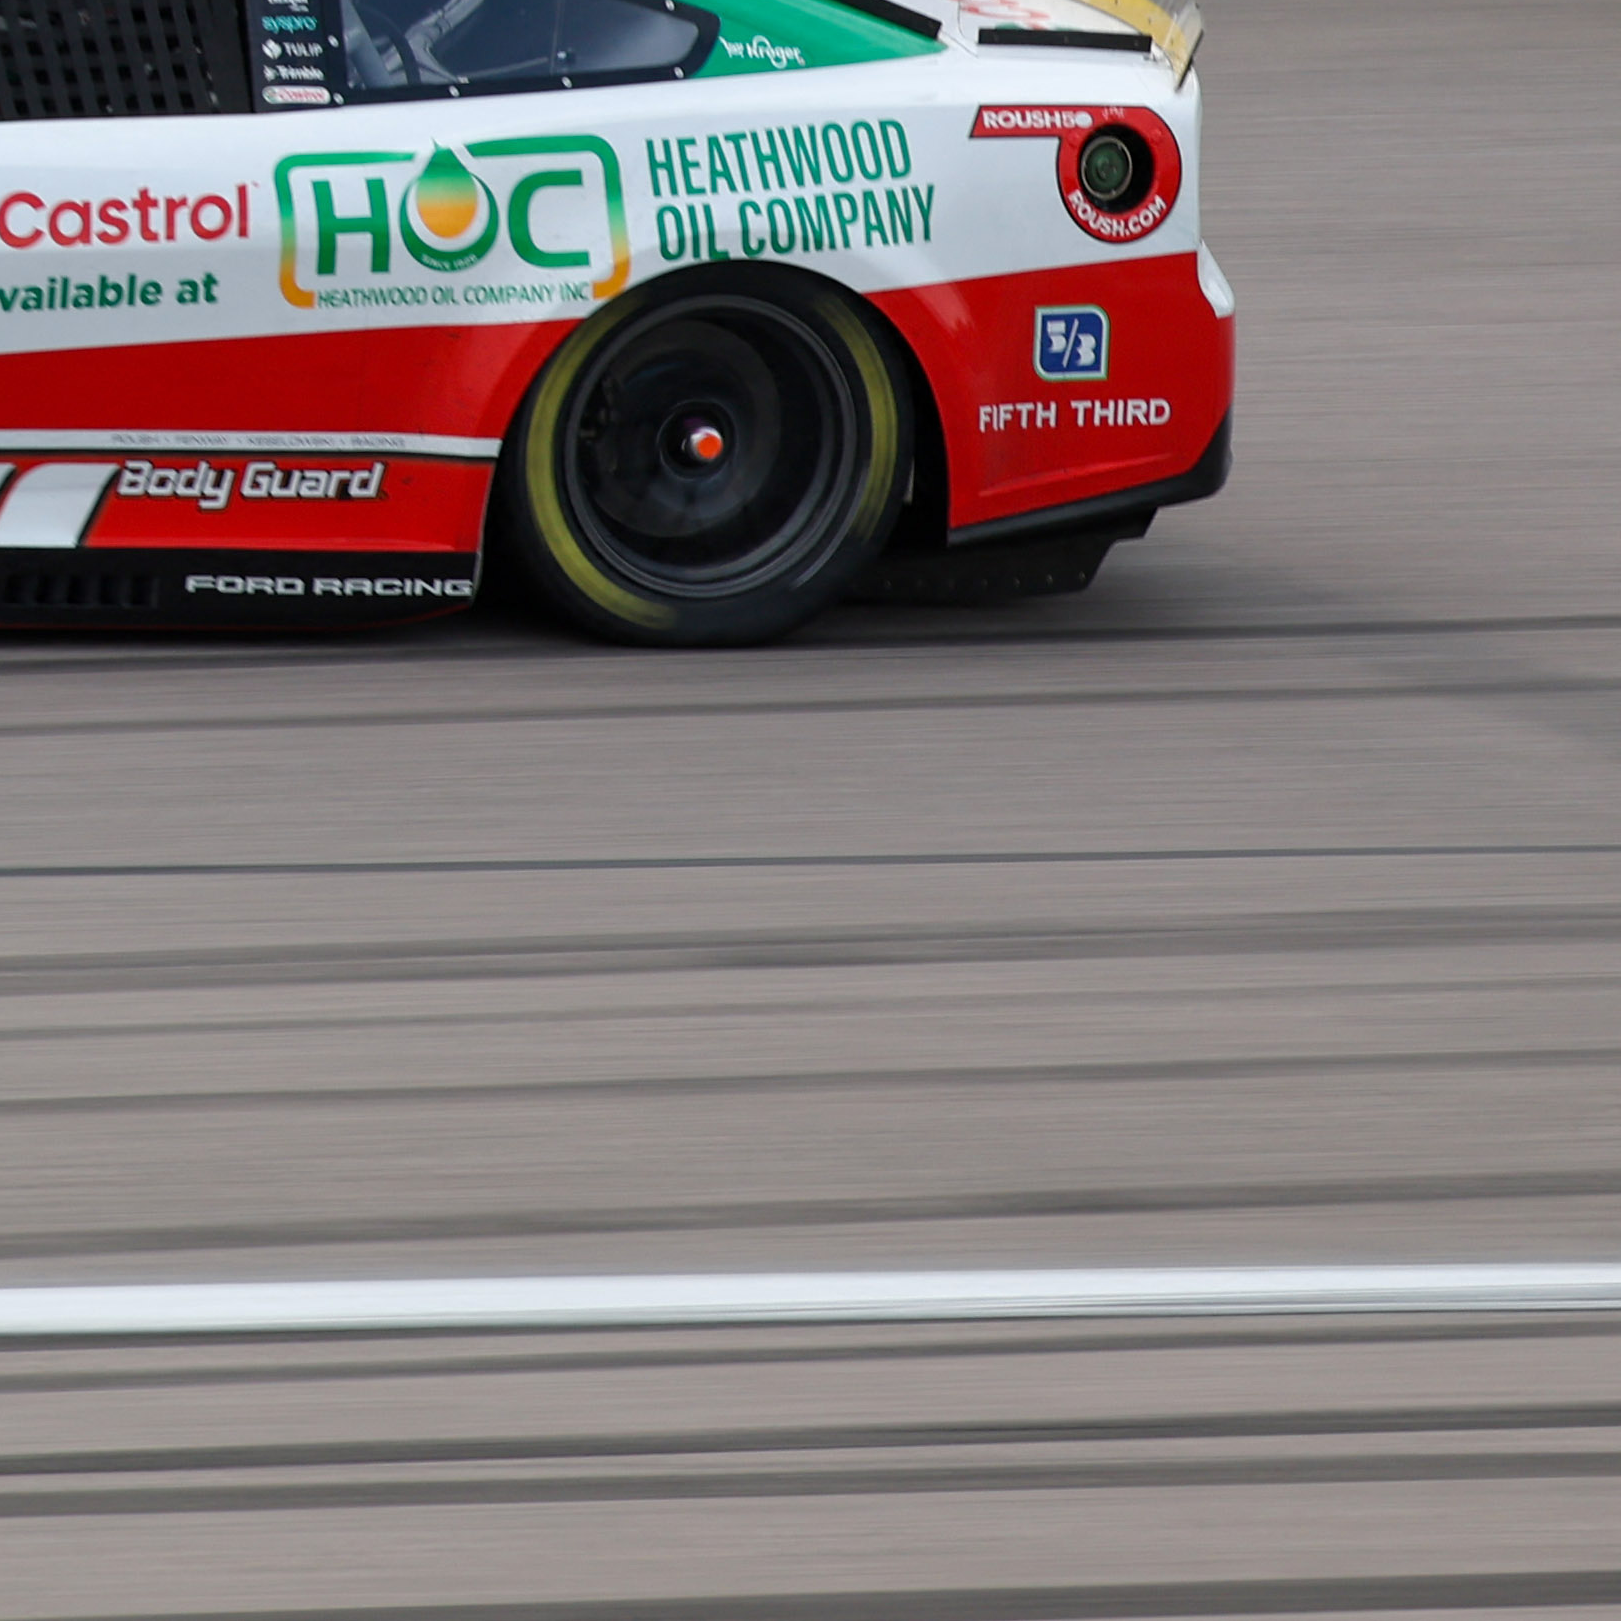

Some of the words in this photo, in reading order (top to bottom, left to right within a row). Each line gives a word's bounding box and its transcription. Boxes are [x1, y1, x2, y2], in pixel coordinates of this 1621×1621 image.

[646, 119, 911, 197] HEATHWOOD
[311, 141, 591, 275] HOC
[657, 202, 730, 261] OIL
[739, 184, 934, 258] COMPANY
[1068, 189, 1167, 237] ROUSH.COM
[176, 272, 219, 305] at
[317, 286, 428, 309] HEATHWOOD
[432, 285, 459, 306] OIL
[463, 283, 554, 305] COMPANY
[561, 281, 589, 301] INC
[978, 401, 1057, 433] FIFTH
[1070, 397, 1171, 427] THIRD
[117, 459, 234, 511] Body
[240, 460, 387, 500] Guard
[185, 575, 304, 596] FORD
[312, 578, 475, 598] RACING
